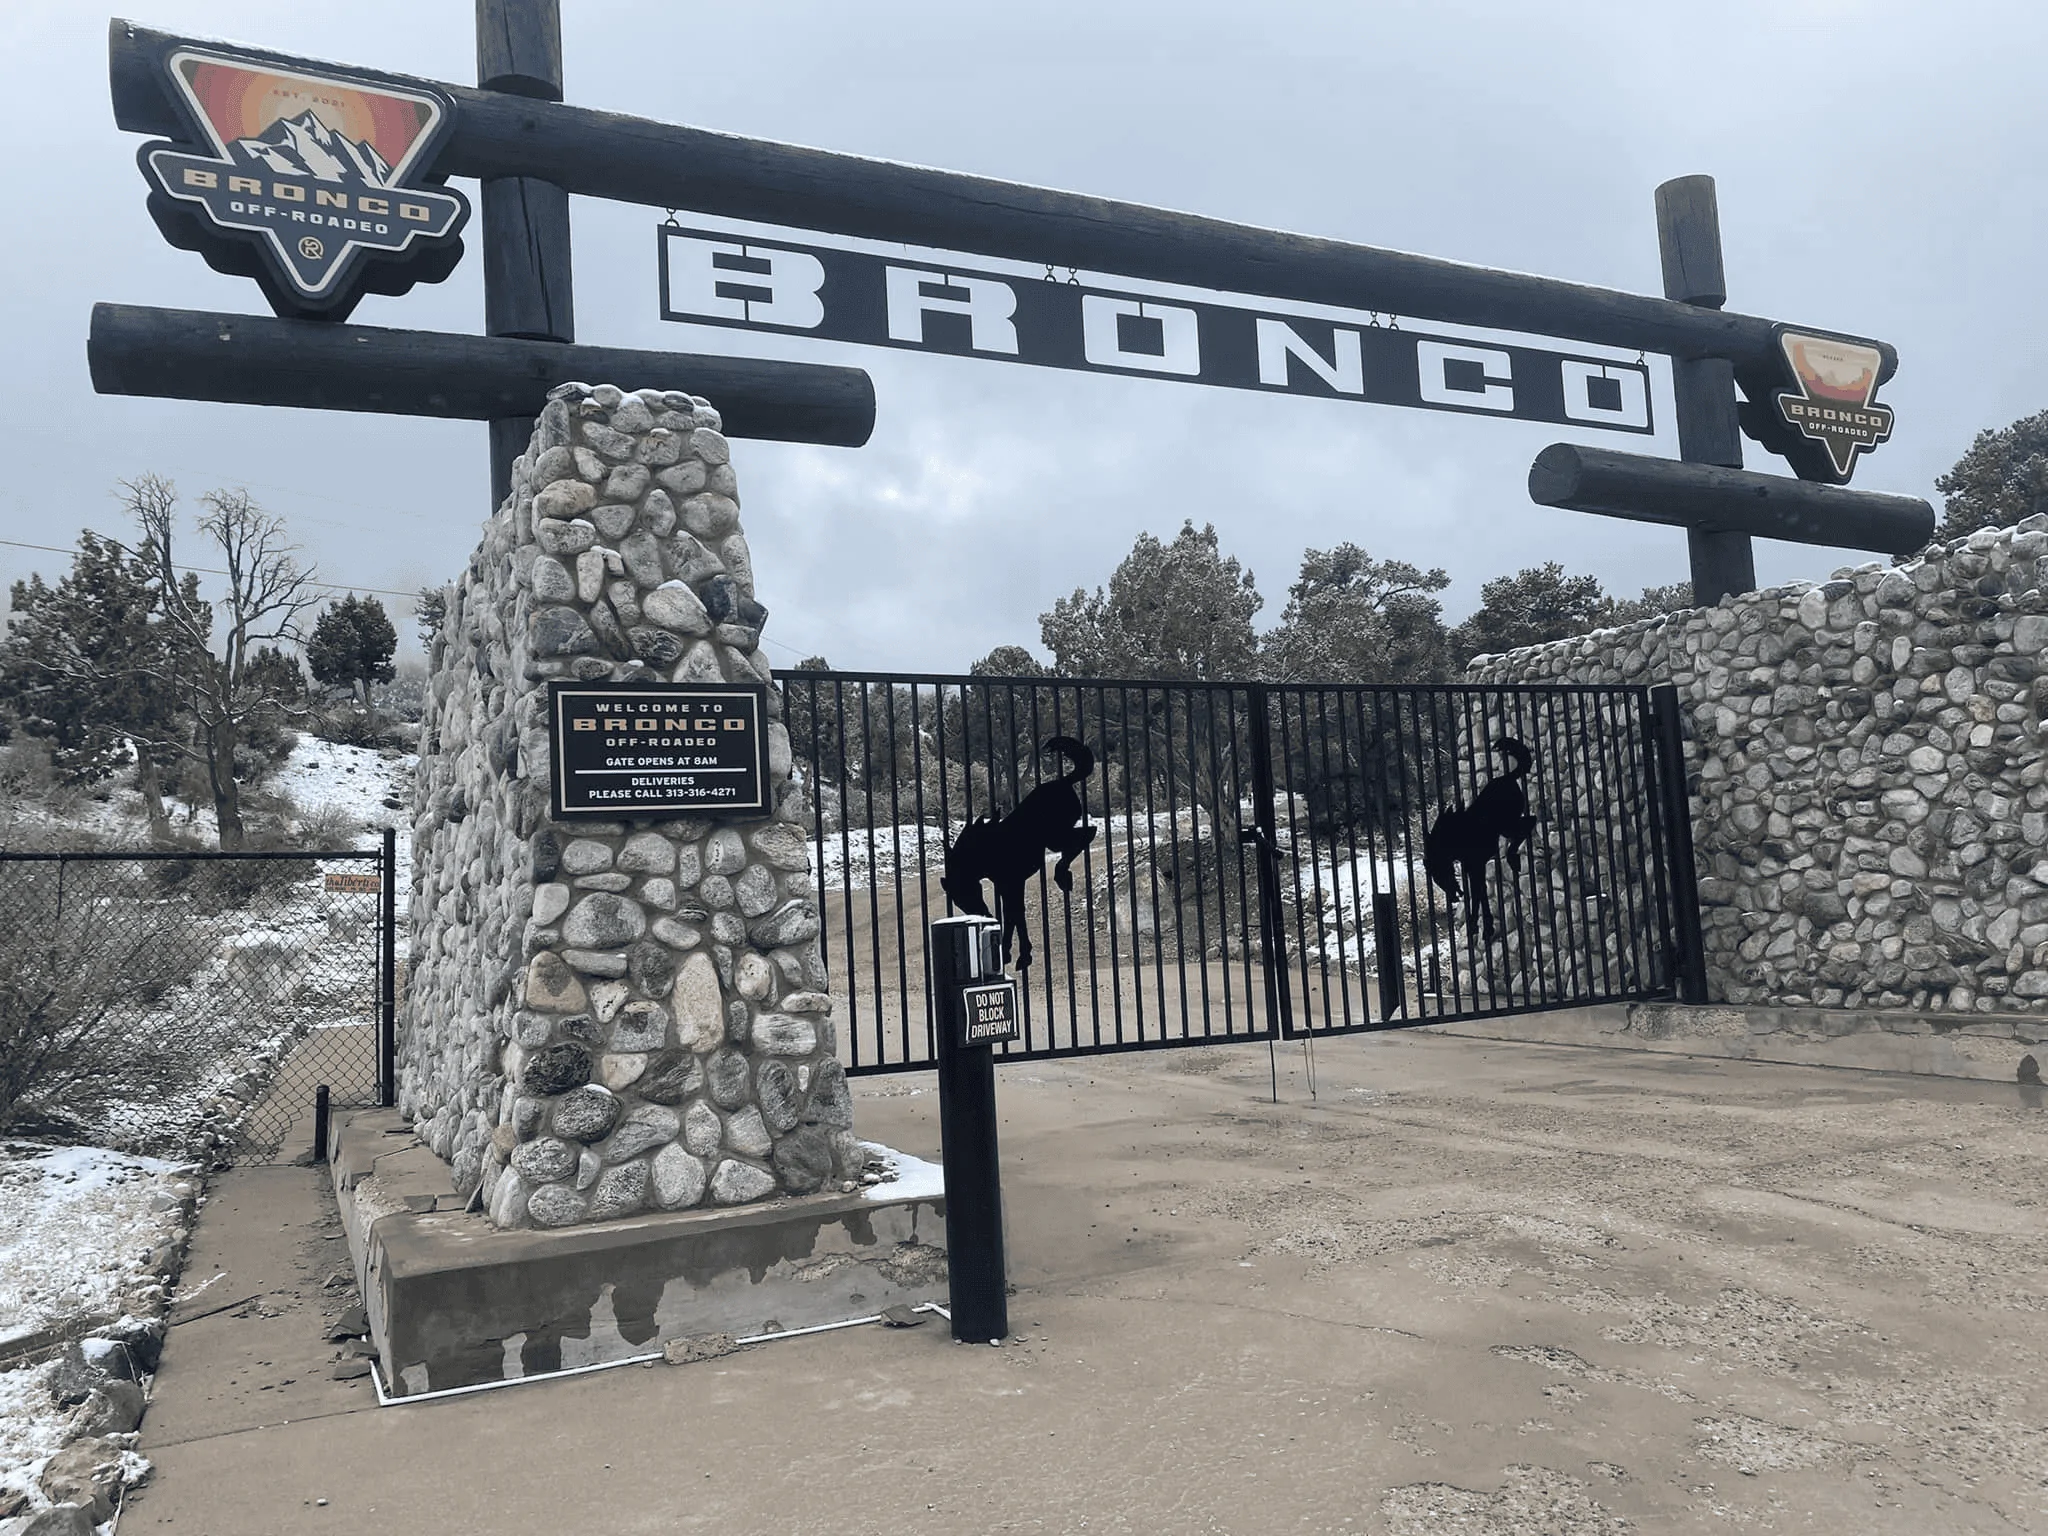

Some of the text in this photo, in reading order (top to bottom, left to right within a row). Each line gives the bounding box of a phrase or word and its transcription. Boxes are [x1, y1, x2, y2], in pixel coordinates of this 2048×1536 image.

[183, 168, 430, 222] BRONCO
[230, 201, 389, 235] OFF-ROADEO
[666, 234, 1649, 429] BRONCO
[1790, 404, 1882, 428] BRONCO
[1809, 422, 1868, 437] OFF-ROADEO
[596, 703, 723, 713] WELCOME TO
[573, 718, 745, 731] BRONCO
[606, 737, 717, 747] OFF-ROADEO
[606, 756, 718, 767] GATE OPENS AT 8AM
[631, 776, 695, 786] DELIVERIES
[588, 787, 736, 799] PLEASE CALL 313-316-4271
[975, 991, 1004, 1008] DO NOT
[978, 1006, 1005, 1021] BLOCK
[971, 1020, 1012, 1038] DRIVEWAY
